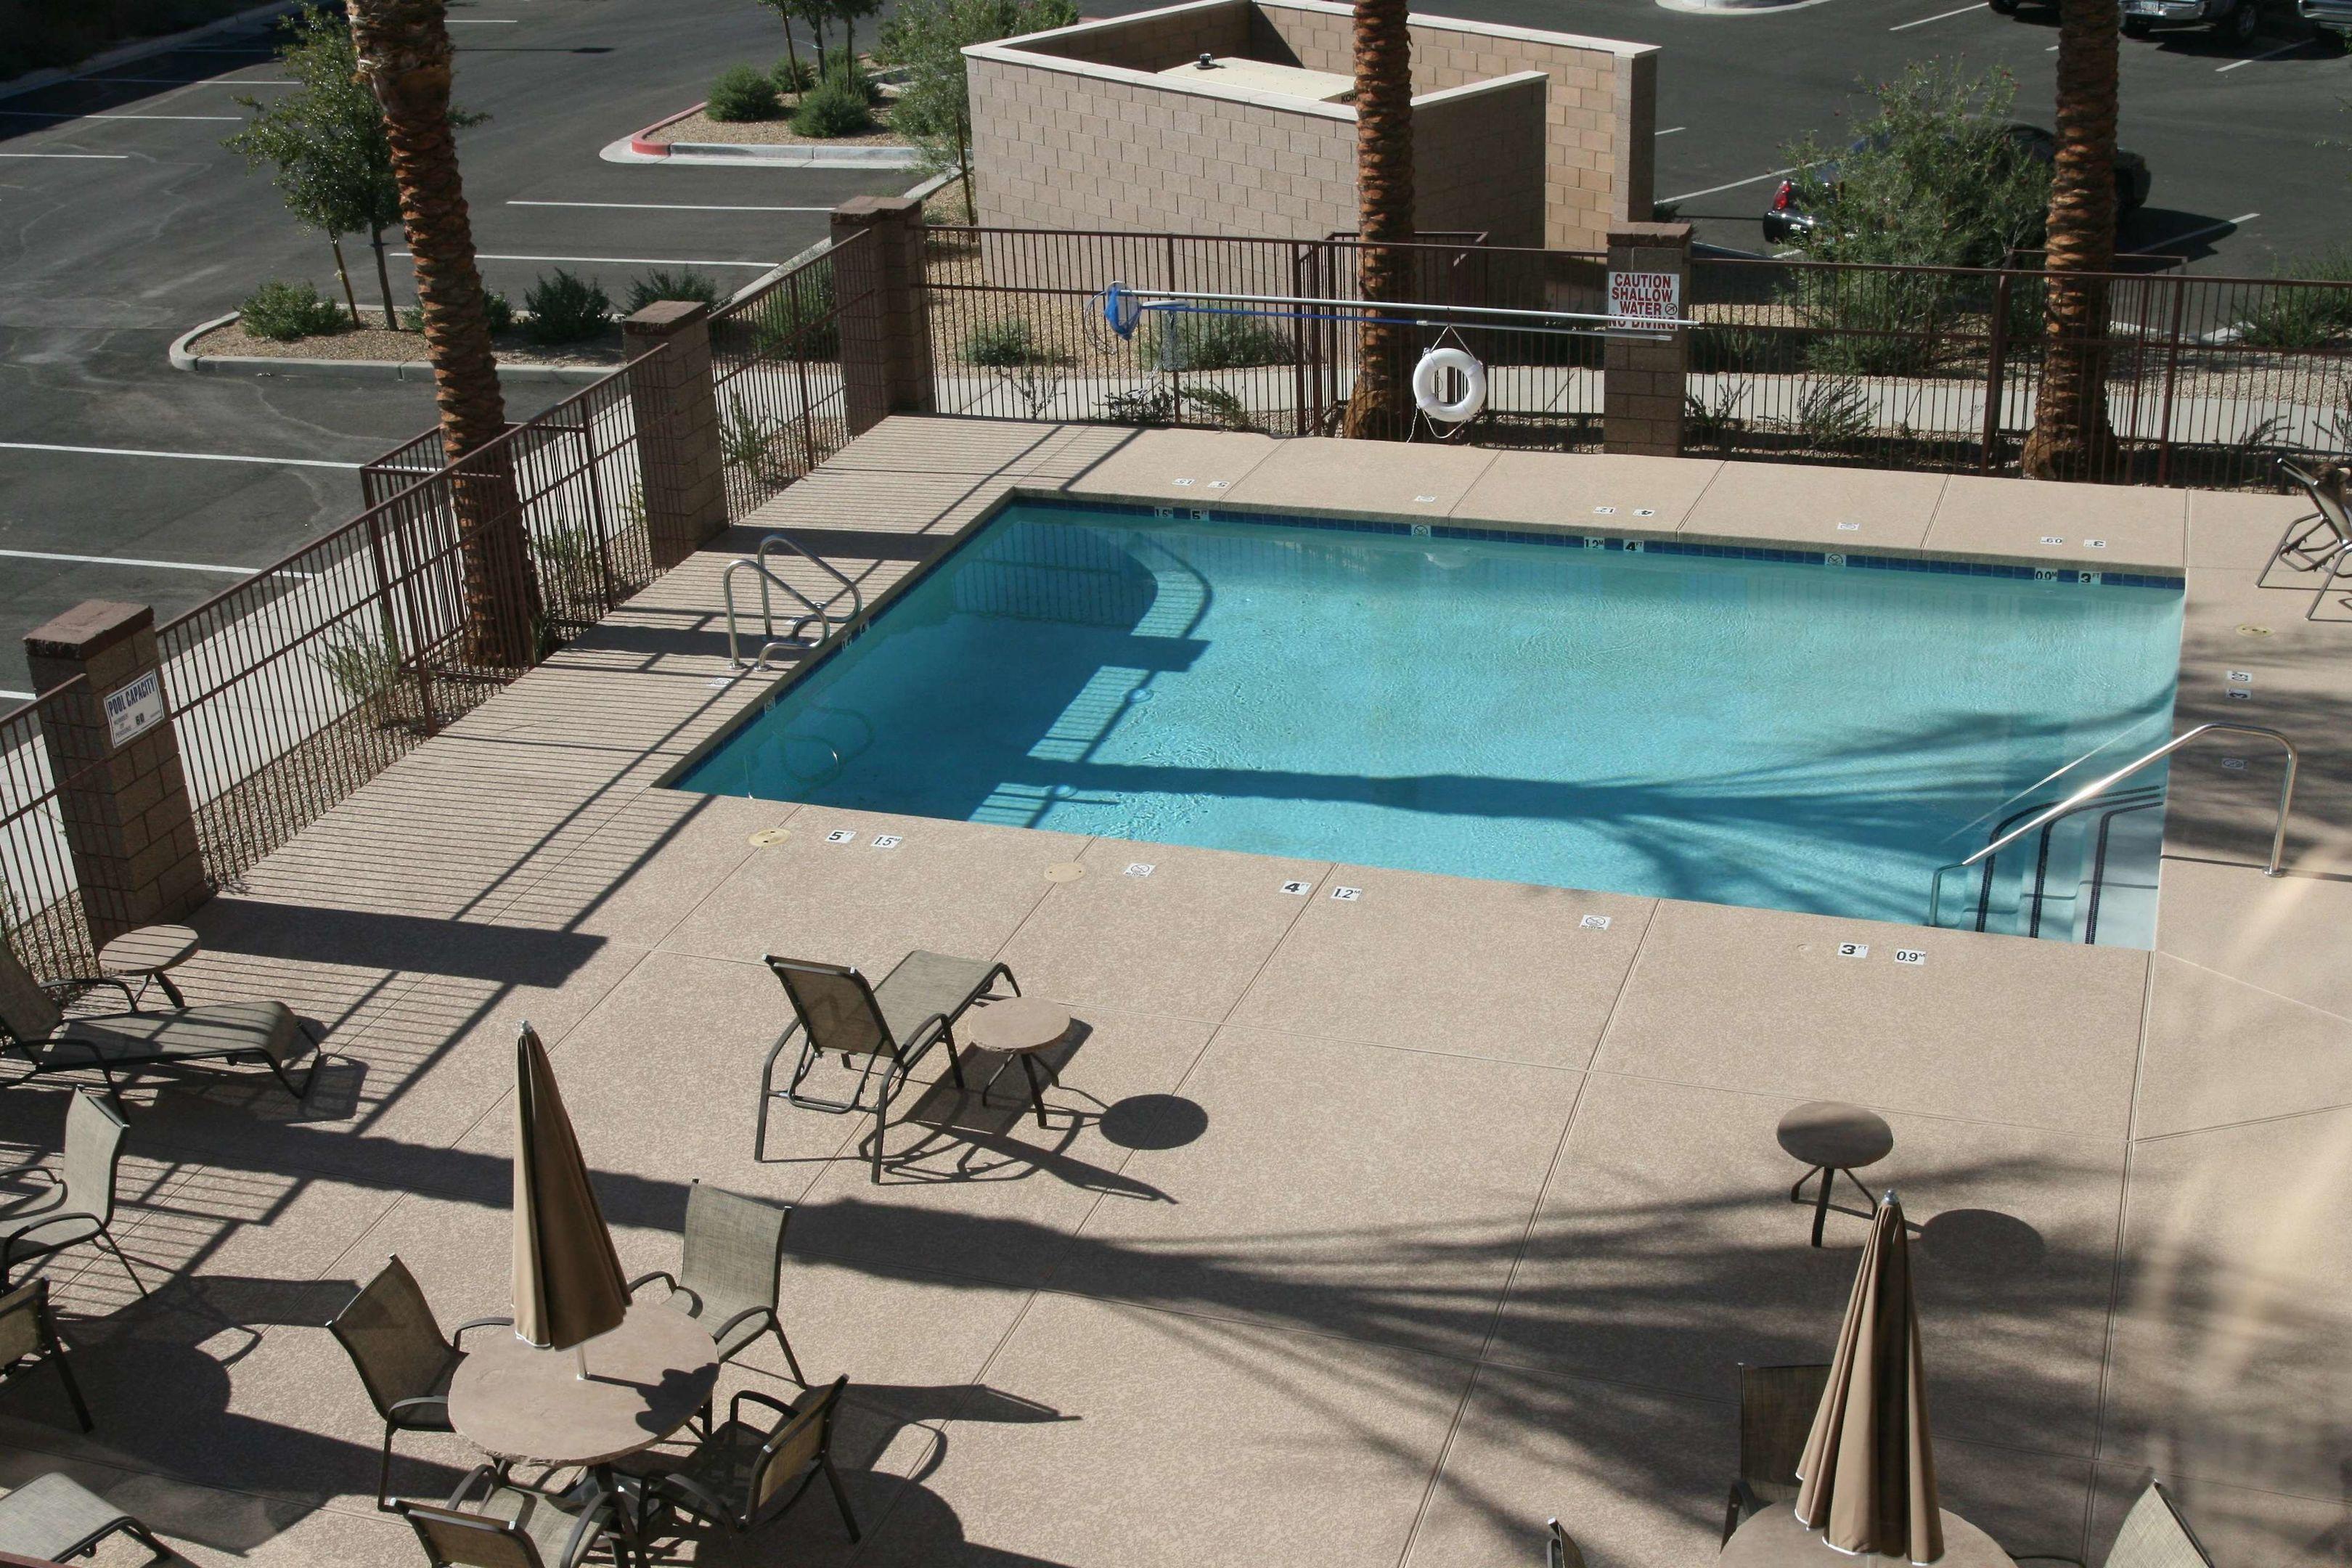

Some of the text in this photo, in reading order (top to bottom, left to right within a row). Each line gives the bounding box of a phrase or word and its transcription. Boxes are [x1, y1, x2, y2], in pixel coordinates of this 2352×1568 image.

[1341, 92, 1357, 104] KOH
[1614, 273, 1670, 289] CAUTION
[1612, 287, 1673, 303] SHALLOW
[1620, 301, 1662, 316] WATER
[1609, 314, 1675, 330] NO DIVING
[107, 677, 155, 717] POOL CAPACITY
